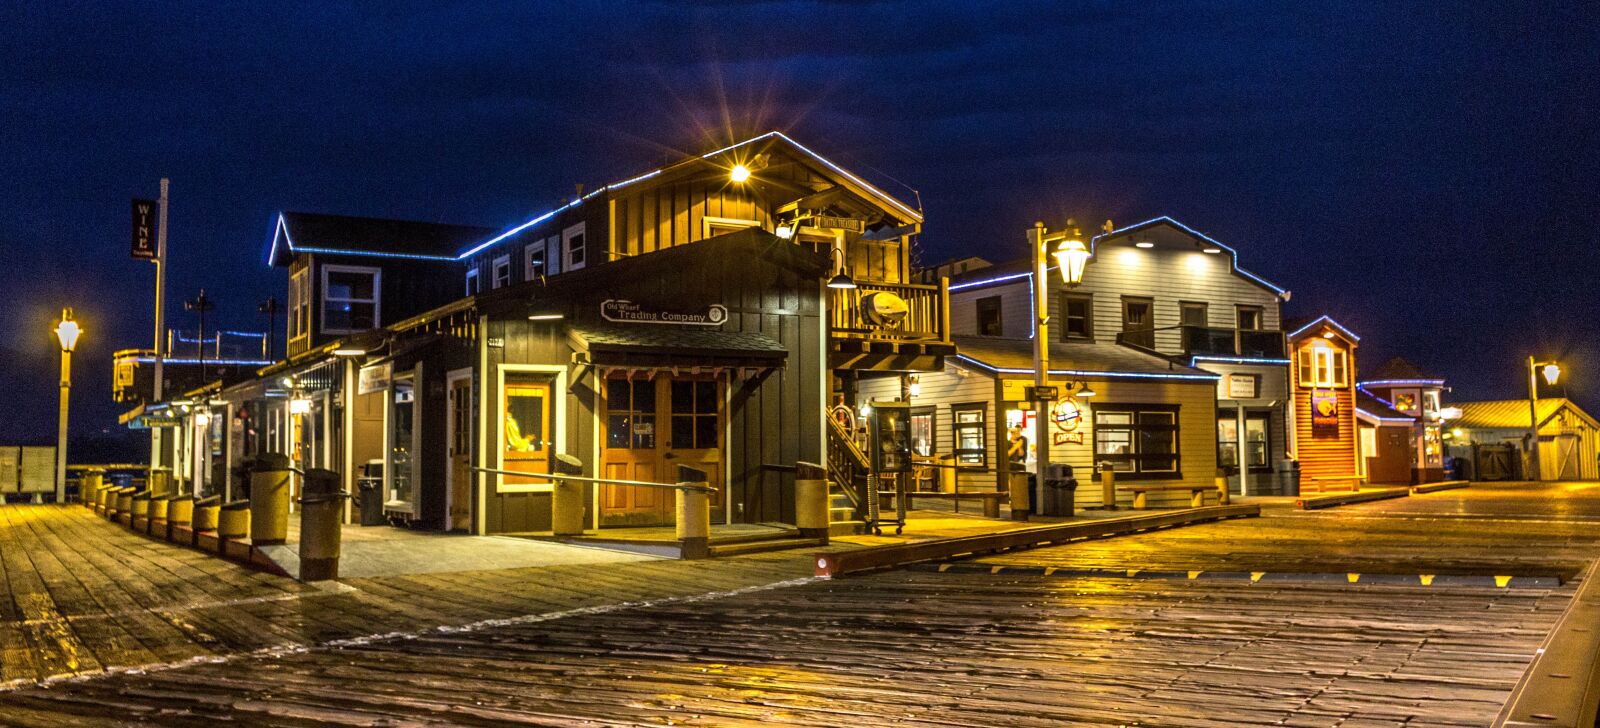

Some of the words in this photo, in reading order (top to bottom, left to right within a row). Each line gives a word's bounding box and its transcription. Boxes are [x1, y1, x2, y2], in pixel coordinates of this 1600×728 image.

[138, 204, 150, 248] WINE
[619, 303, 640, 311] Wharf
[619, 310, 657, 320] Trading
[661, 311, 706, 322] Company
[1056, 433, 1082, 443] OPEN
